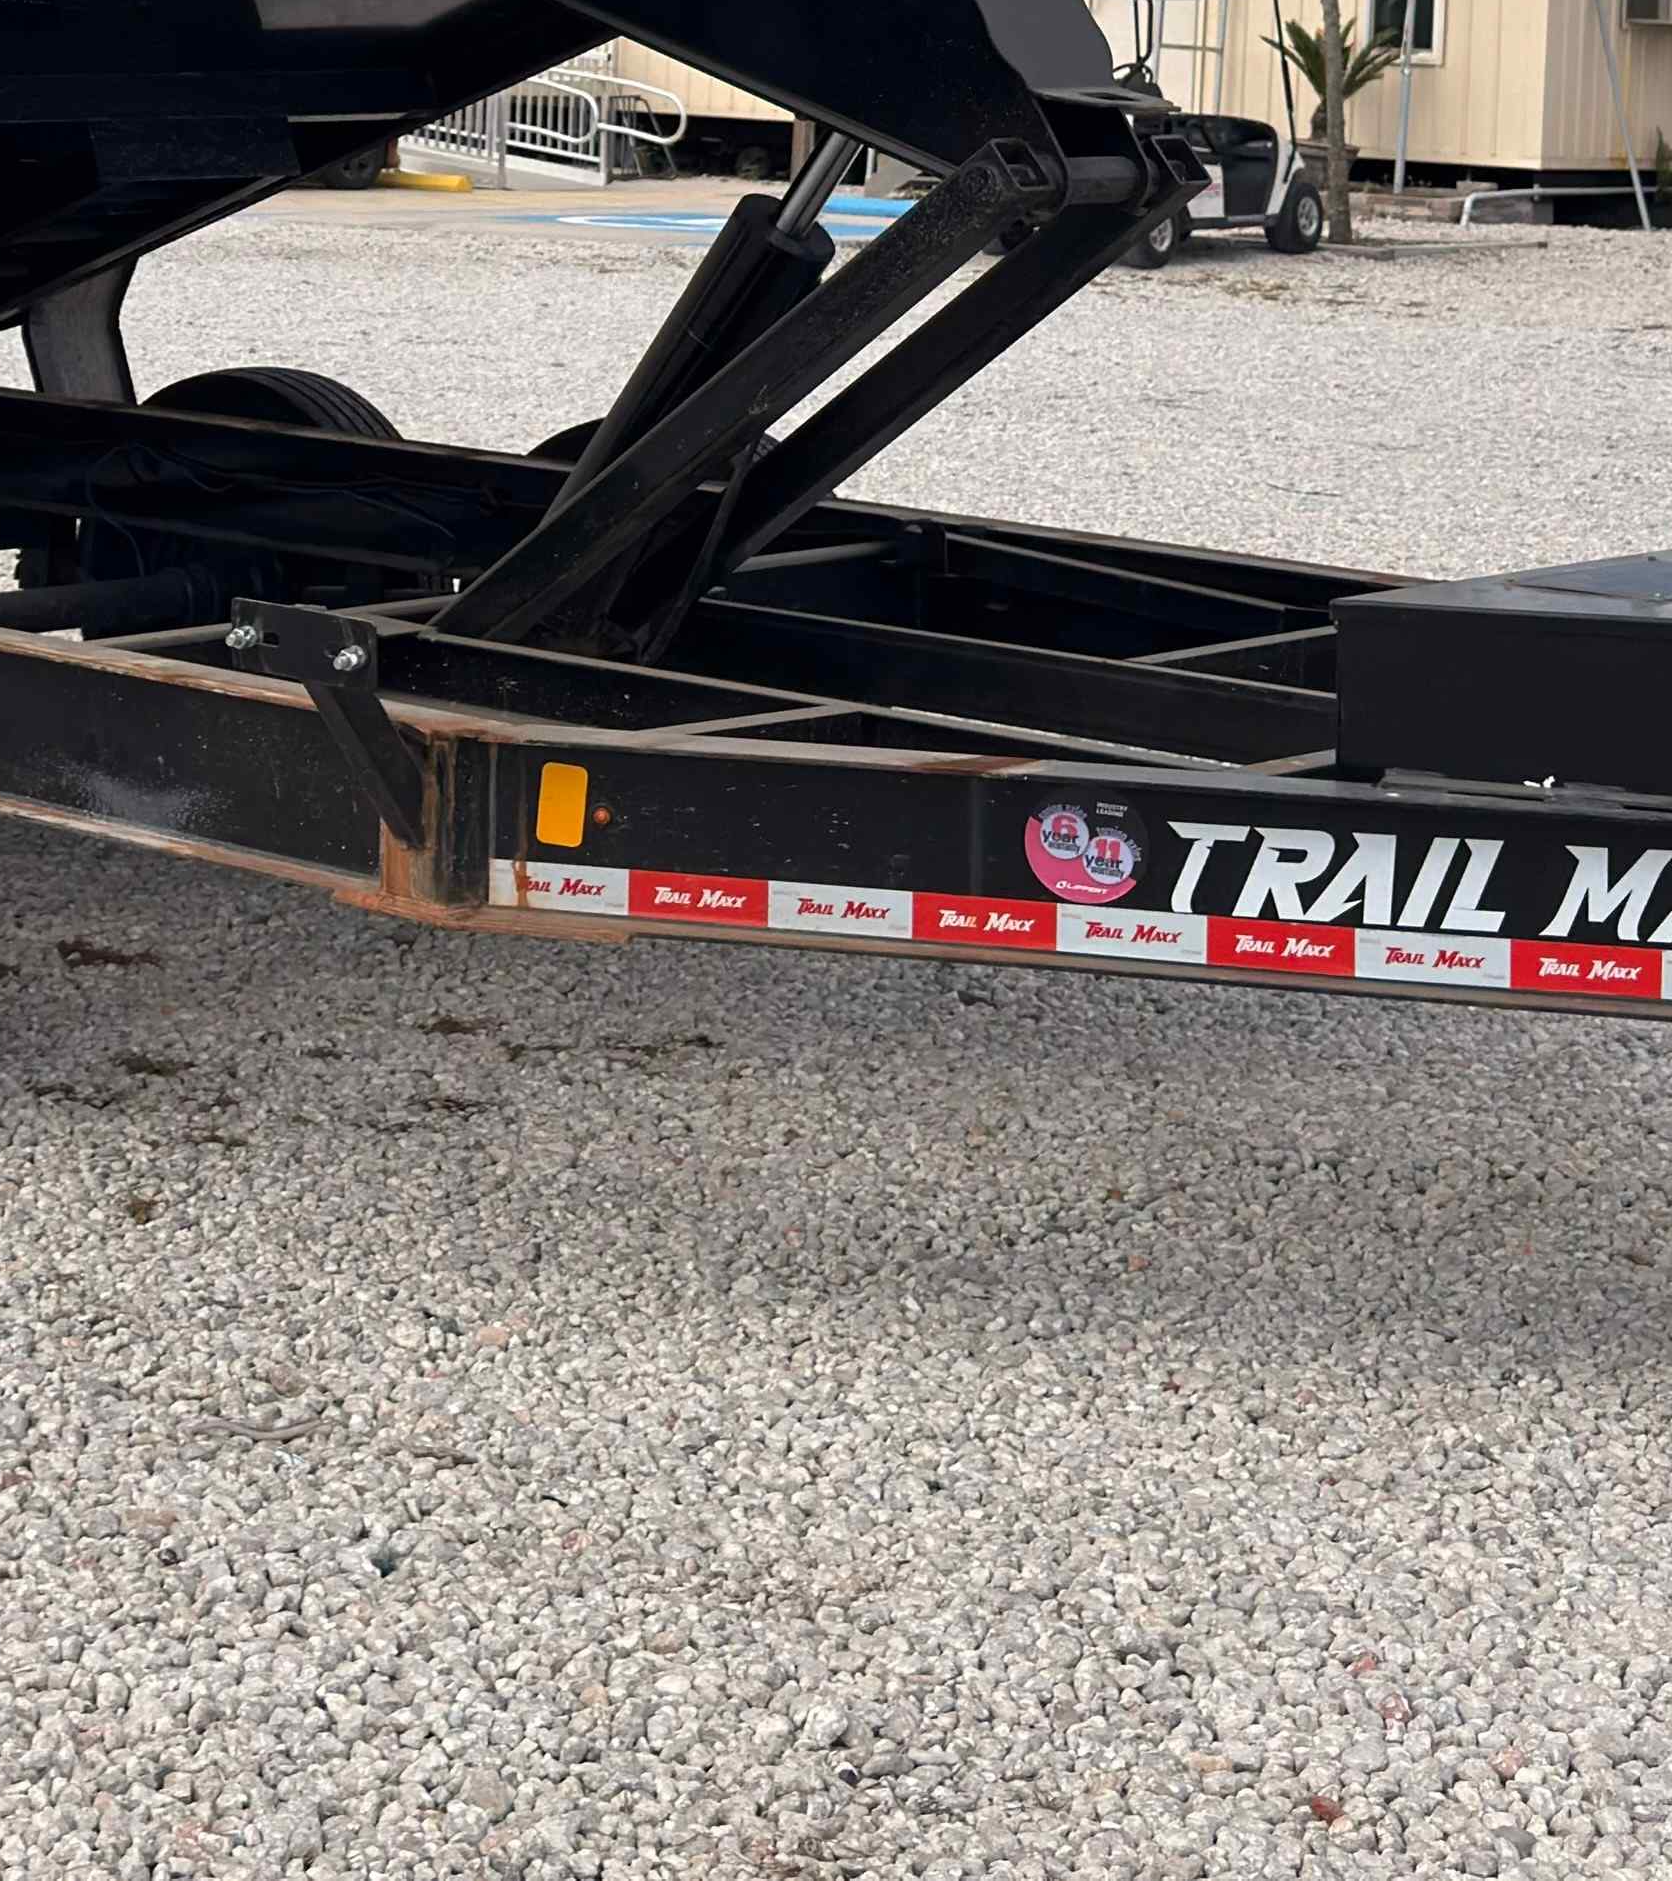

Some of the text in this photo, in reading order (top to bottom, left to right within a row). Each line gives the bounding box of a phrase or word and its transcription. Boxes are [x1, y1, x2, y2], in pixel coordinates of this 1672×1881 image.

[1042, 829, 1080, 844] year
[1095, 838, 1121, 861] 11
[1085, 854, 1123, 869] year
[1166, 820, 1506, 930] TRAIL
[558, 877, 606, 897] MAXX
[653, 886, 747, 908] TRAIL MAXX
[796, 897, 891, 920] TRAIL MAXX
[937, 909, 1035, 932] TRAIL MAXX
[1084, 921, 1182, 944] TRAIL MAXX
[1234, 934, 1336, 958] TRAIL MAXX
[1384, 946, 1486, 969] TRAIL MAXX
[1538, 957, 1642, 981] TRAIL MAXX
